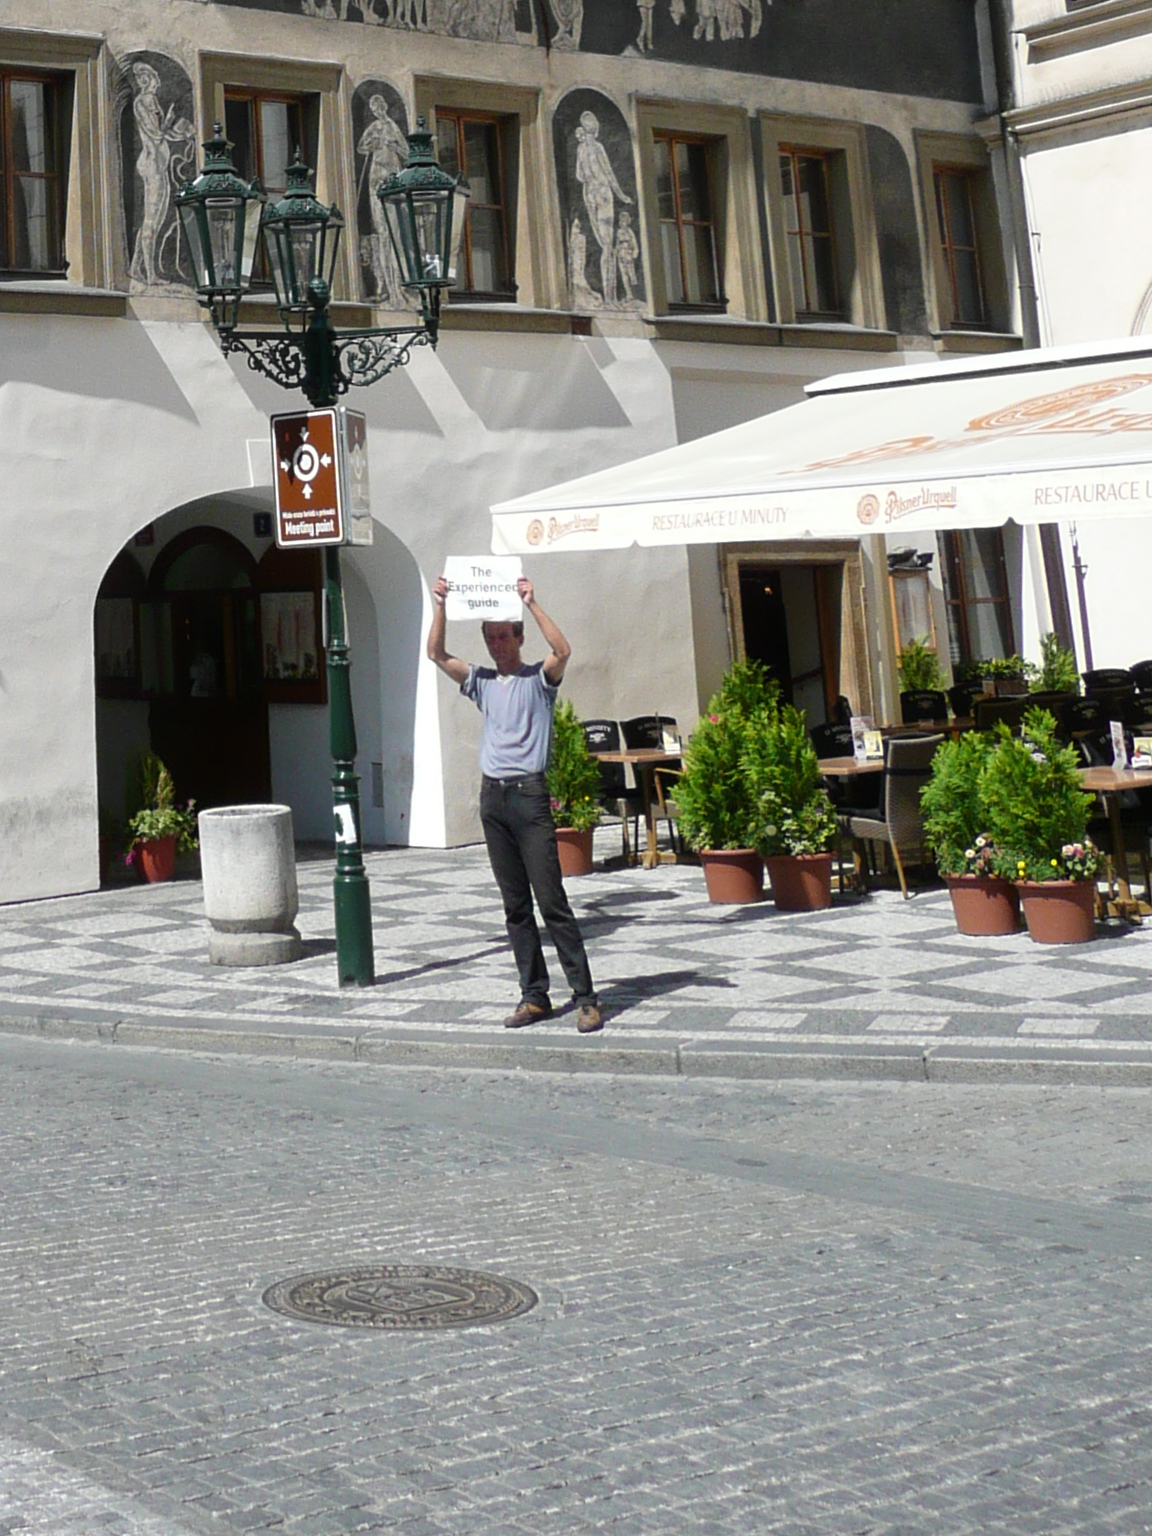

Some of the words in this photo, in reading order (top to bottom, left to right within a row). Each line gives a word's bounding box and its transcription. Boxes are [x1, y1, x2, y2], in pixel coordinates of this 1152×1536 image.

[1034, 481, 1140, 506] RESTAURACE
[885, 490, 921, 524] Pilsner
[921, 486, 957, 512] Urquell
[284, 520, 315, 537] Meeting
[315, 518, 335, 537] point
[652, 509, 726, 531] RESTAURACE
[728, 510, 738, 526] U
[741, 507, 789, 525] MINUTY
[470, 566, 493, 577] The
[467, 597, 500, 610] guide
